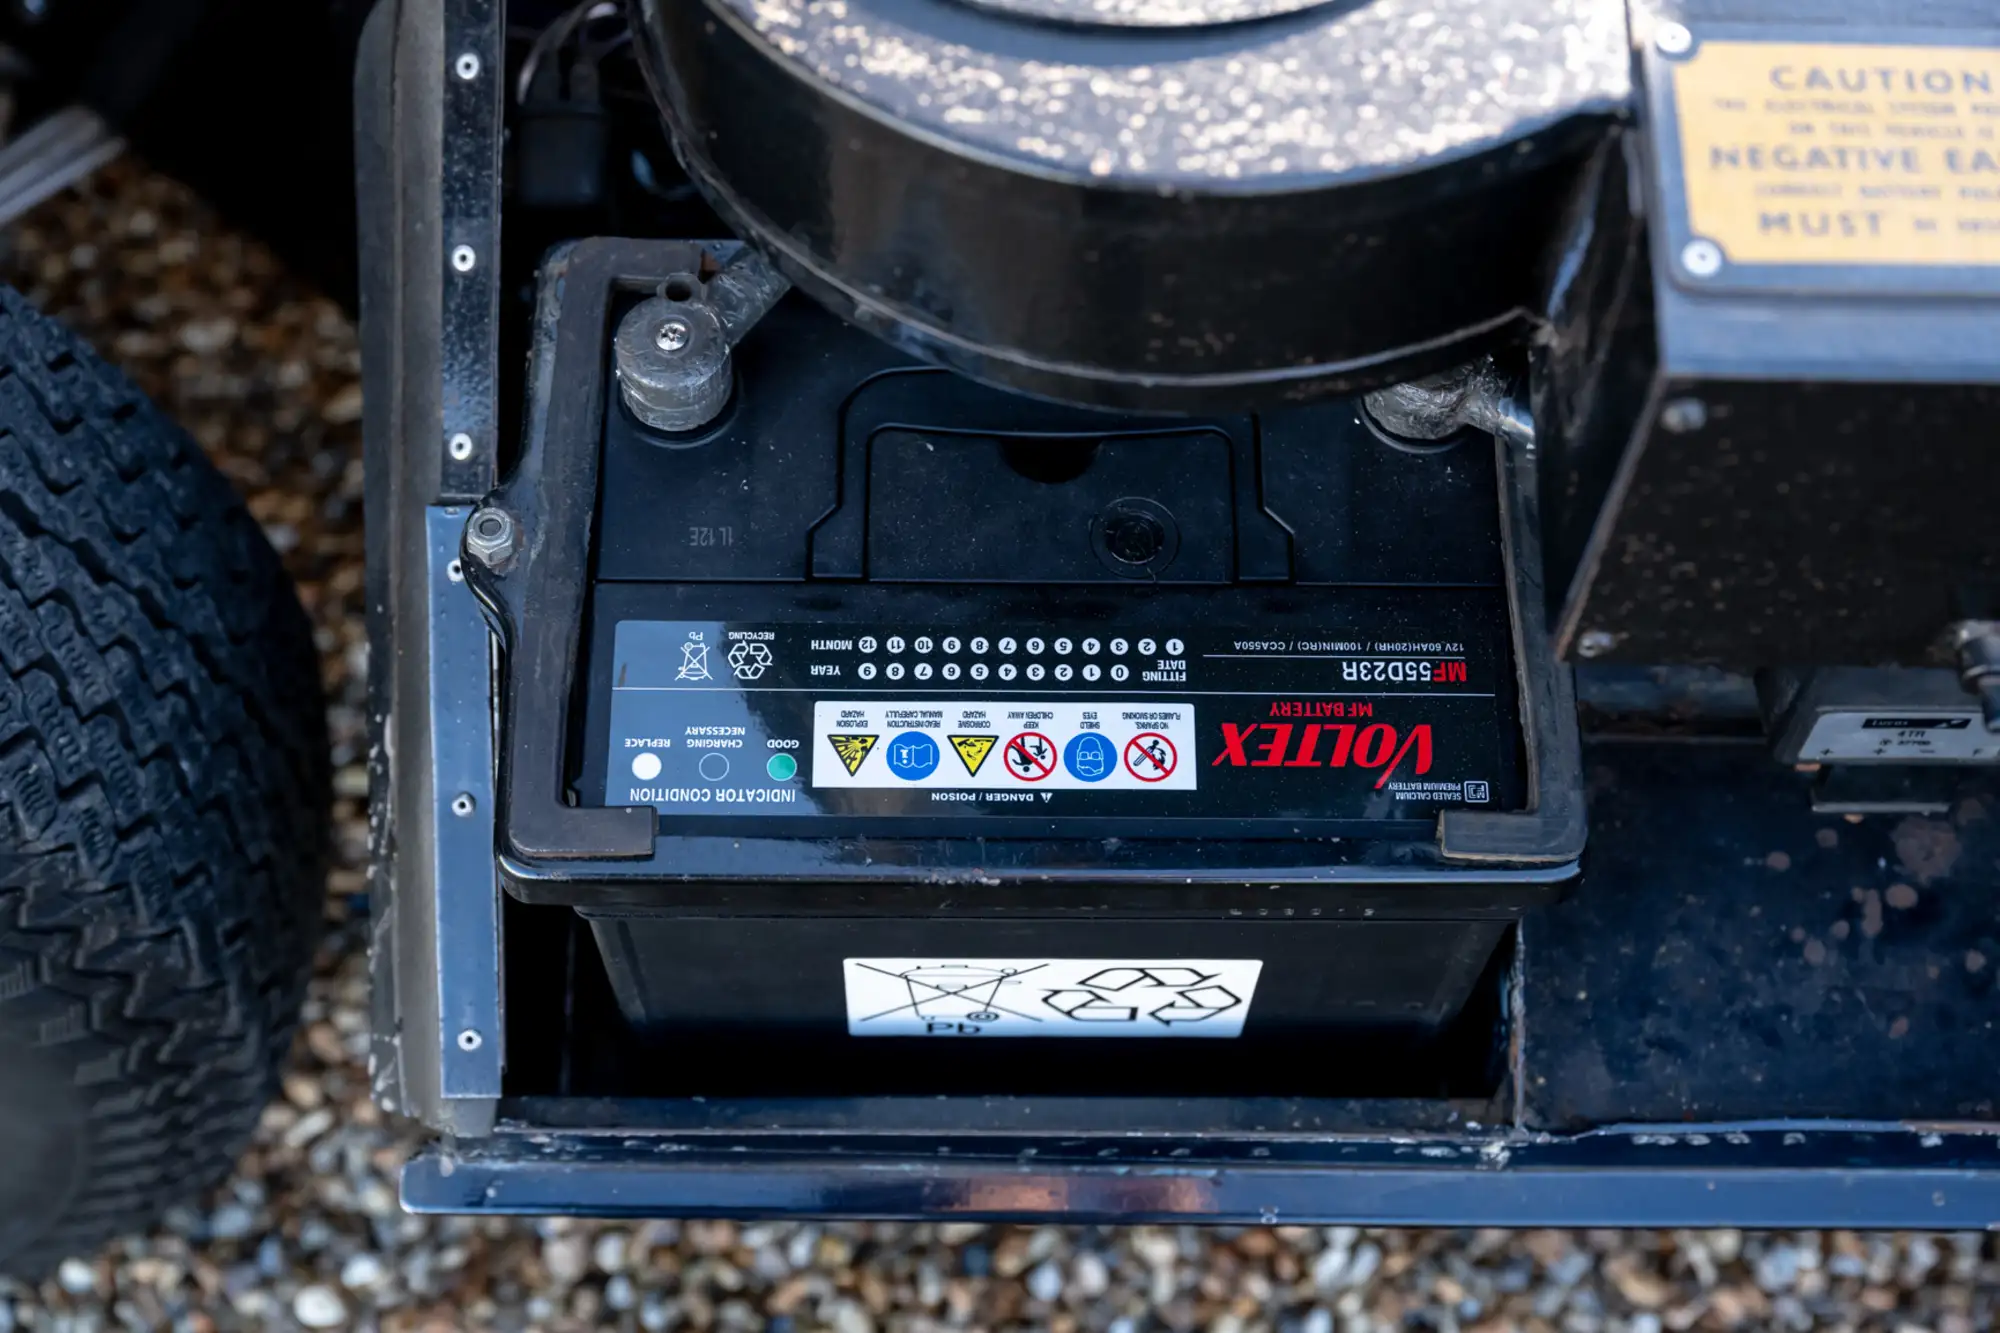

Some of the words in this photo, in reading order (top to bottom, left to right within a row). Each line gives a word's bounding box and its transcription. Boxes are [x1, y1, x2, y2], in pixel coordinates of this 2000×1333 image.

[1769, 67, 1992, 94] CAUTION
[1709, 144, 1919, 173] NEGATIVE
[1758, 210, 1884, 237] MUST
[688, 631, 703, 641] Pb
[728, 631, 775, 640] RECYCLING
[811, 640, 853, 650] MONTH
[1233, 641, 1286, 650] CCA550A
[1297, 640, 1363, 651] 100MIN(RC)
[1374, 641, 1441, 652] 60AH(20HR)
[1444, 642, 1464, 652] 12V
[1157, 659, 1186, 669] DATE
[811, 665, 841, 675] YEAR
[1342, 661, 1467, 682] MF55D23R
[1142, 670, 1186, 681] FITTING
[841, 710, 865, 718] HAZARD
[885, 710, 918, 718] CAREFULLY
[919, 710, 943, 718] MANUAL
[1269, 701, 1344, 717] BATTERY
[1347, 701, 1372, 717] MF
[836, 720, 868, 728] EXPLOSION
[887, 720, 923, 728] INSTRUCTION
[924, 720, 941, 728] READ
[684, 726, 745, 736] NECESSARY
[624, 738, 671, 747] REPLACE
[686, 738, 743, 747] CHARGING
[767, 739, 799, 748] GOOD
[1211, 723, 1433, 789] VOLTEX
[1388, 782, 1422, 790] BATTERY
[1423, 782, 1461, 790] PREMIUM
[630, 788, 711, 802] CONDITION
[715, 788, 795, 803] INDICATOR
[931, 792, 976, 801] POISON
[986, 792, 1034, 802] DANGER
[1396, 792, 1431, 800] CALCIUM
[1432, 792, 1462, 800] SEALED
[926, 1022, 982, 1035] Pb
